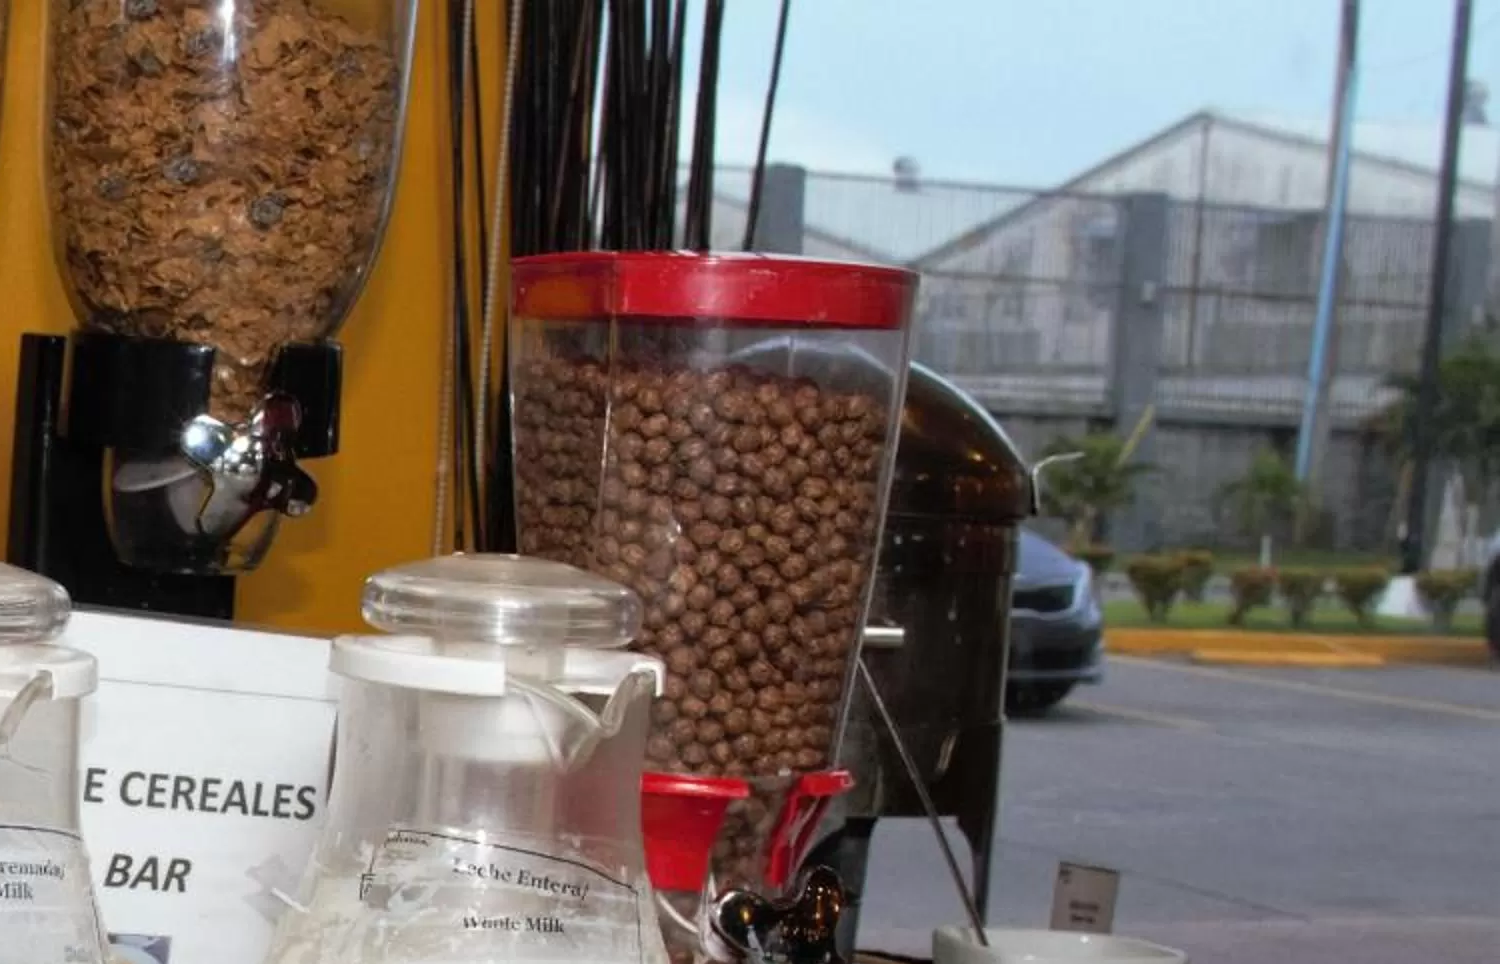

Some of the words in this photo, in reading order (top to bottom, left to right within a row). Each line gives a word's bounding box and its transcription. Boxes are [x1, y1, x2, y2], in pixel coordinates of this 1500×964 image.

[119, 771, 317, 821] CEREALES
[103, 853, 191, 893] BAR
[525, 916, 565, 933] Milk
